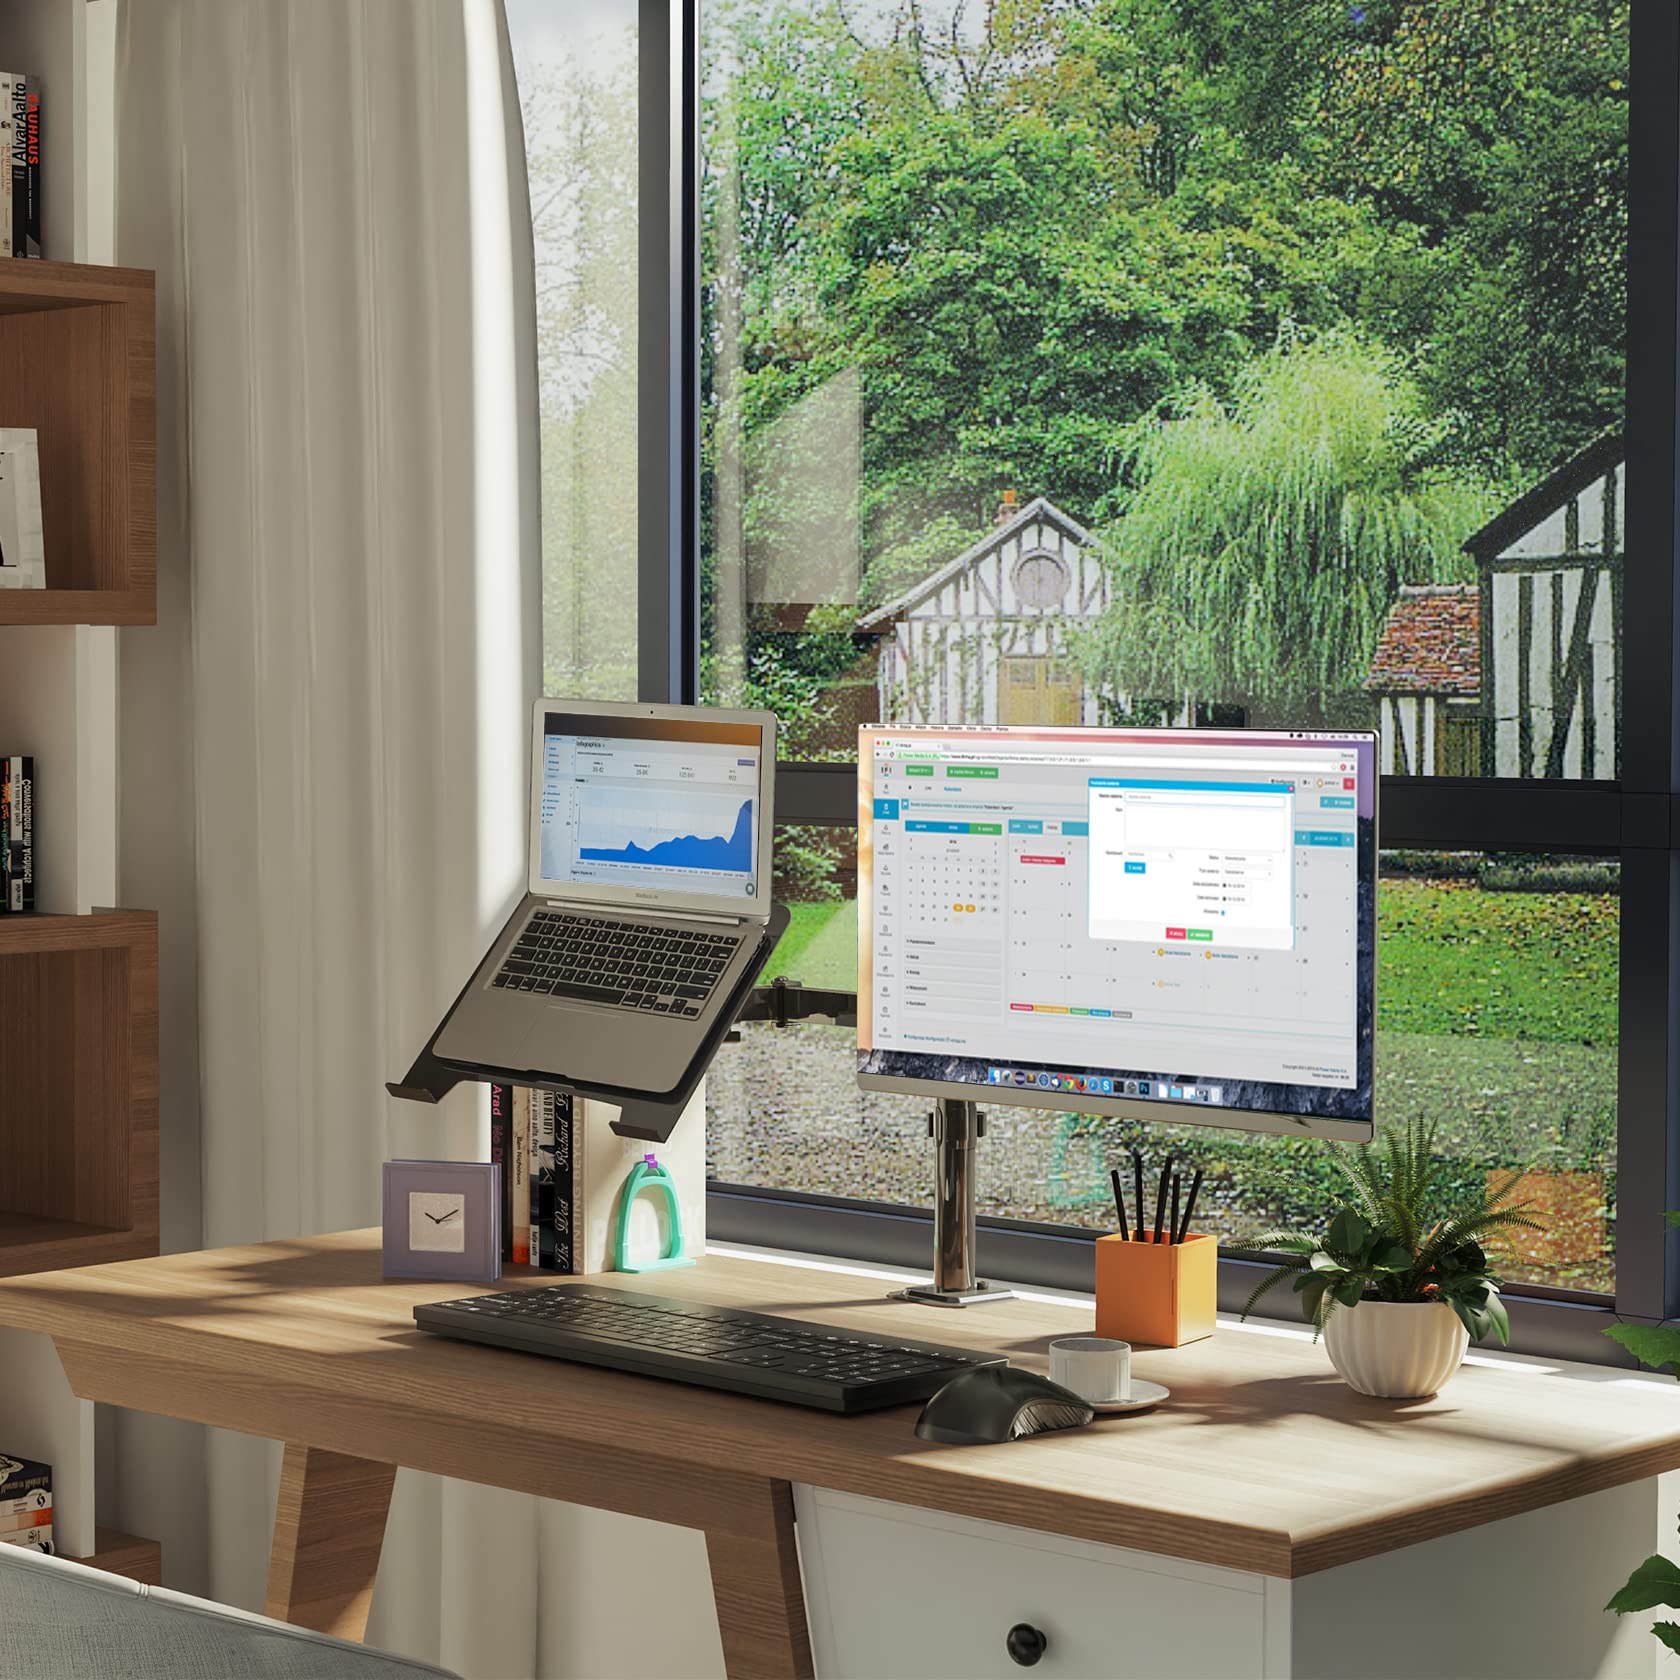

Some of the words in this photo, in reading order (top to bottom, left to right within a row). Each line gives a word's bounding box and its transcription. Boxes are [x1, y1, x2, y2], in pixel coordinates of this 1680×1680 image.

[28, 93, 38, 165] BAUHAUS
[492, 1083, 503, 1116] Arad
[492, 1124, 503, 1143] No
[543, 1107, 554, 1137] BEAUTY
[531, 1138, 540, 1157] design
[555, 1112, 570, 1172] Richard
[574, 1108, 582, 1181] BEYOND
[574, 1186, 582, 1272] PAINTING
[555, 1242, 570, 1269] The
